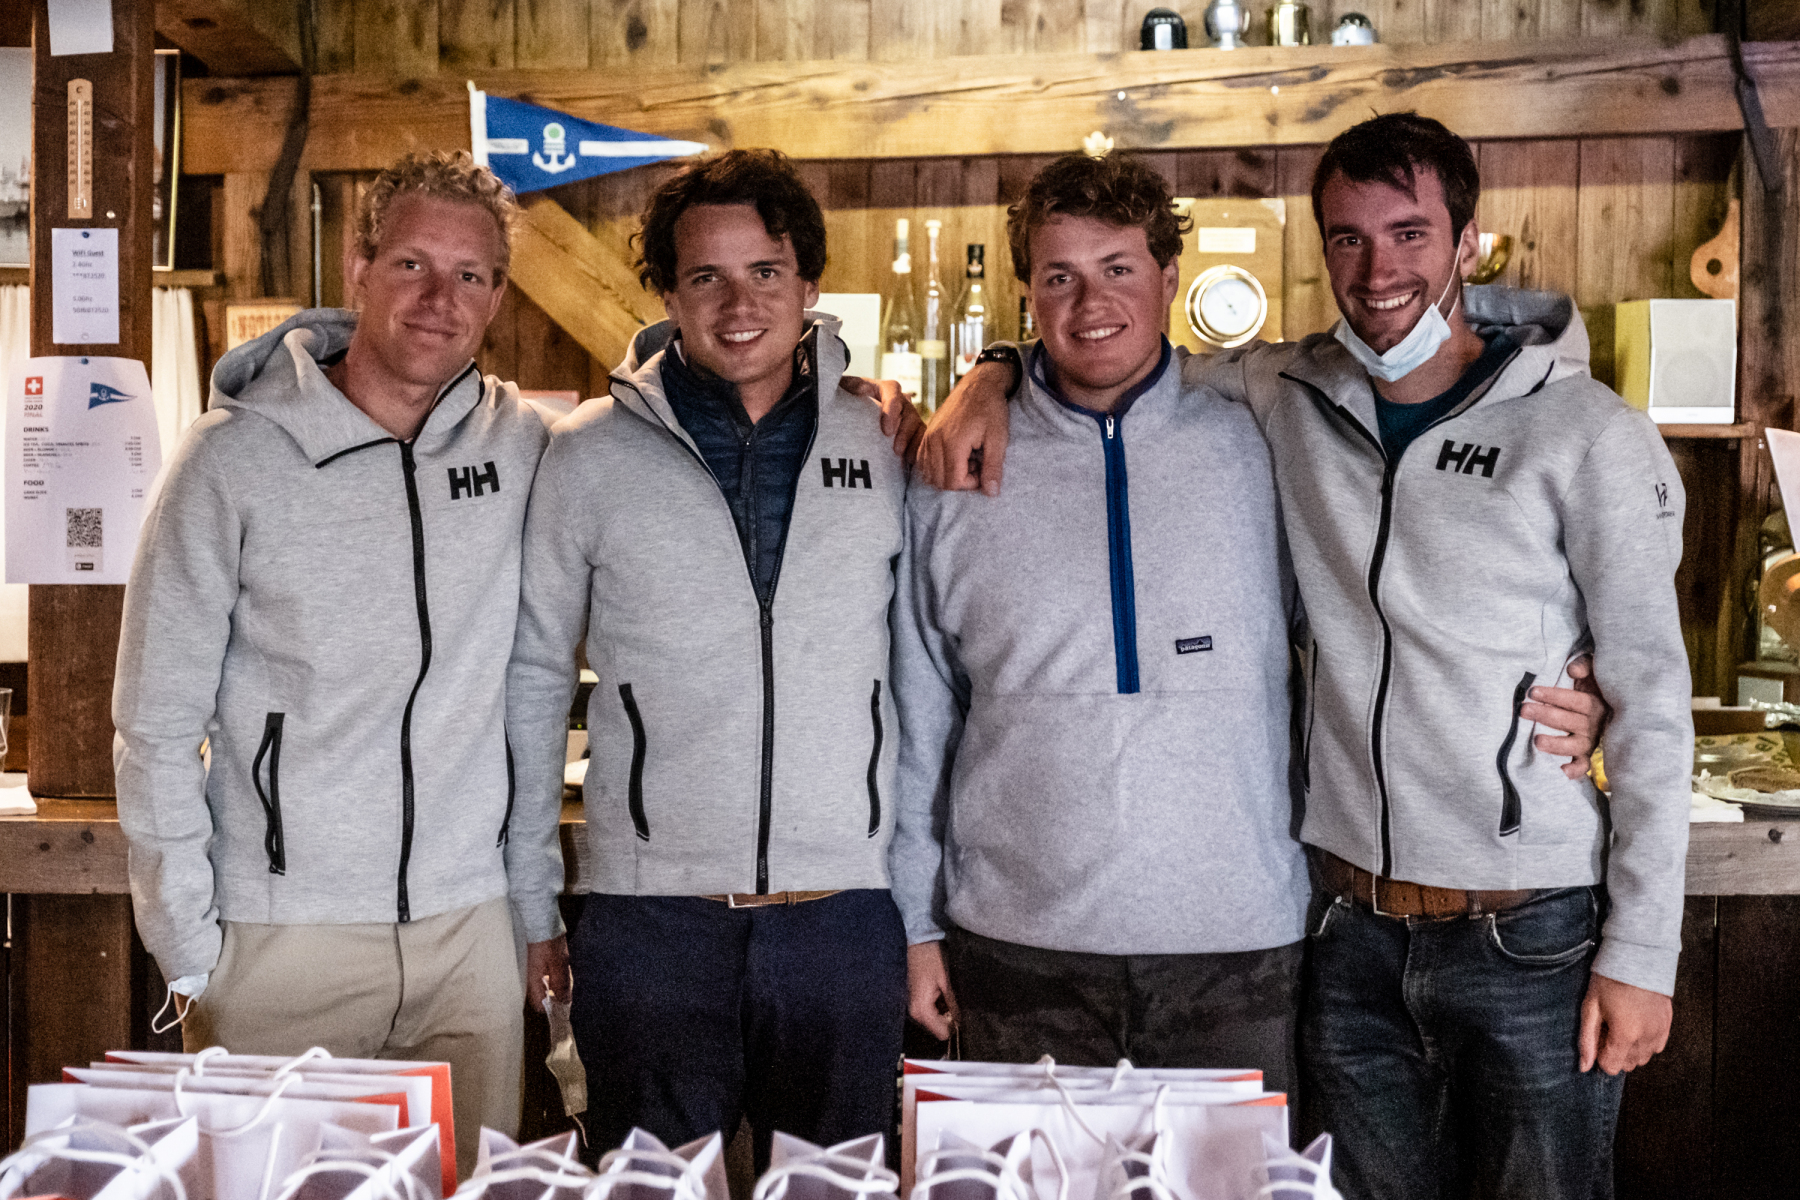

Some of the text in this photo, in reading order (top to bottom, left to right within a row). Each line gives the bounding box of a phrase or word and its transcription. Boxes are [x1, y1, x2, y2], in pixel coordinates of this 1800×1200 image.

[821, 457, 872, 489] HH
[1436, 439, 1501, 478] HH
[447, 461, 500, 500] HH
